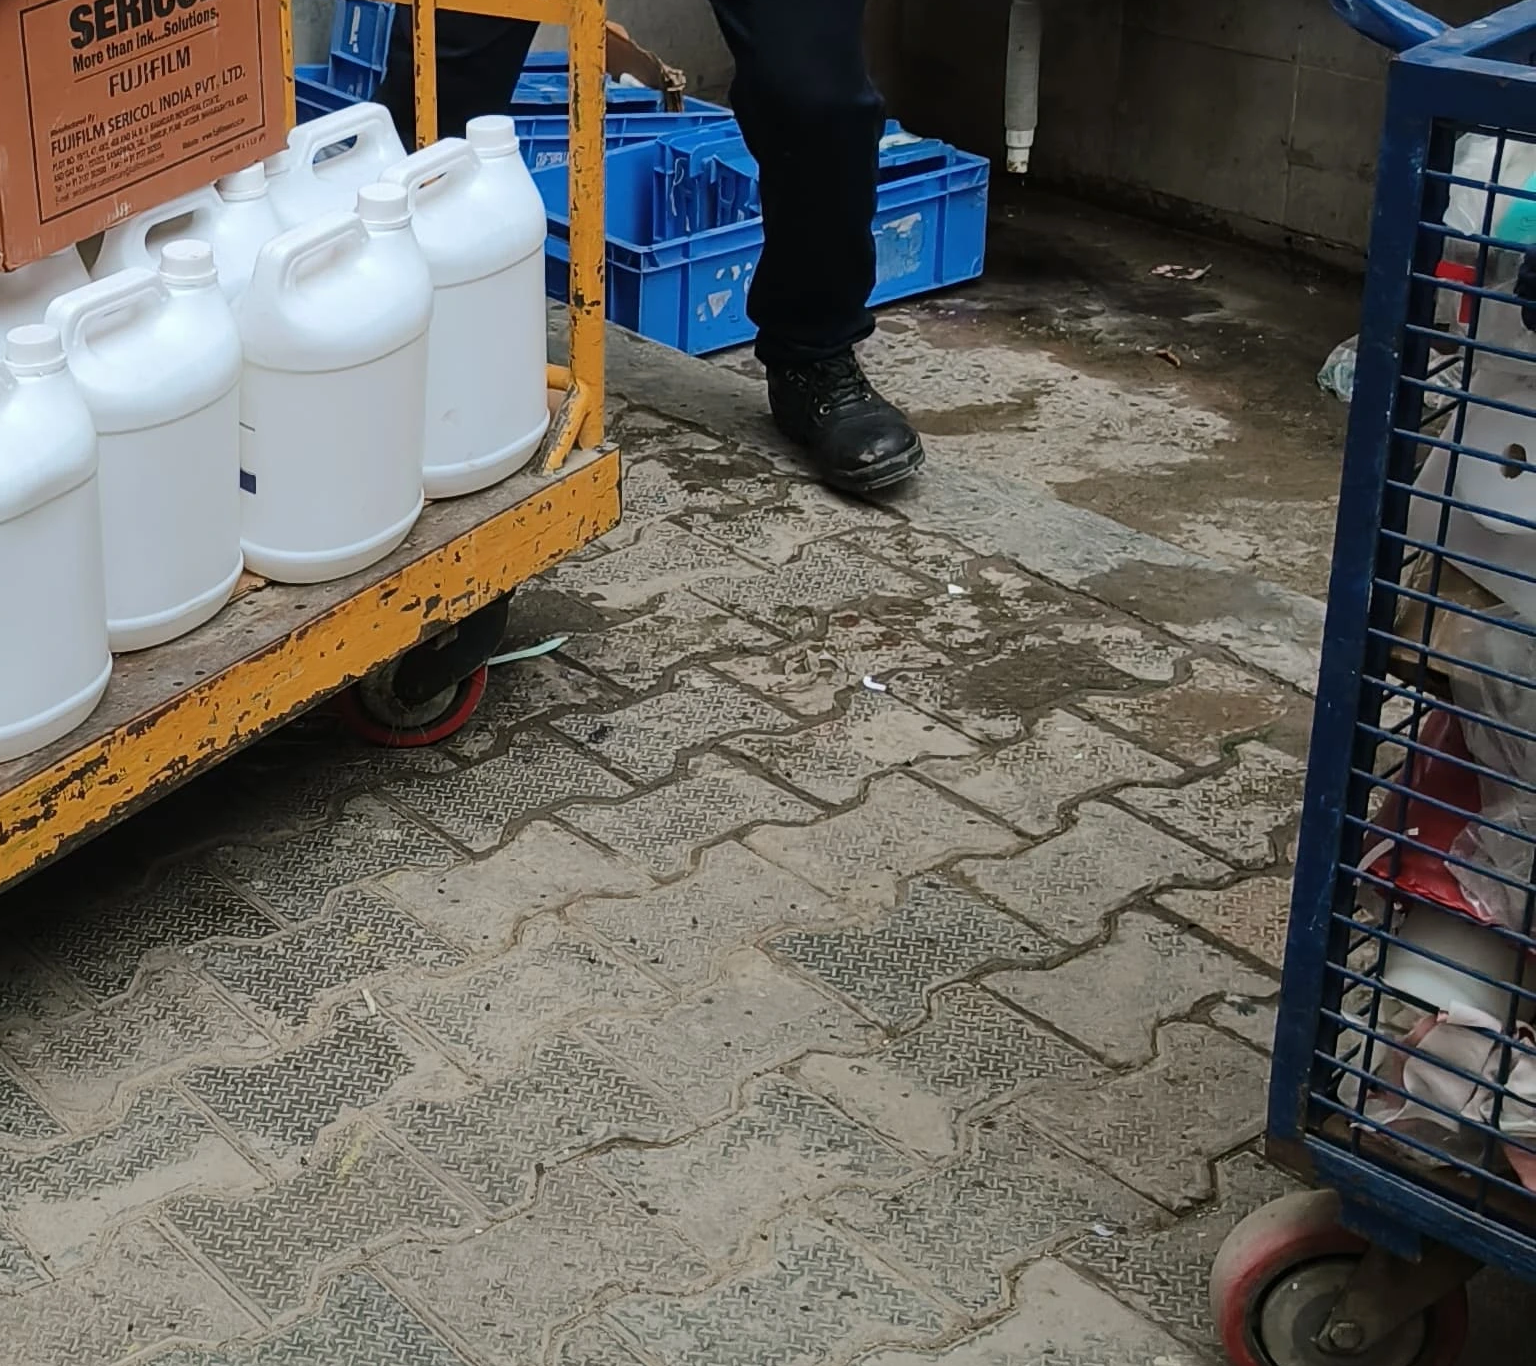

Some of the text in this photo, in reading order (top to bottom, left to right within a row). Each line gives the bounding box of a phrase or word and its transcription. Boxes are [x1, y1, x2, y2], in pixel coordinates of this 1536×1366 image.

[72, 51, 104, 74] More
[106, 40, 134, 61] than
[109, 46, 191, 97] FUJIFILM
[50, 122, 106, 157] FUJIFILM
[107, 102, 157, 134] SERICOL
[159, 85, 193, 113] INDIA
